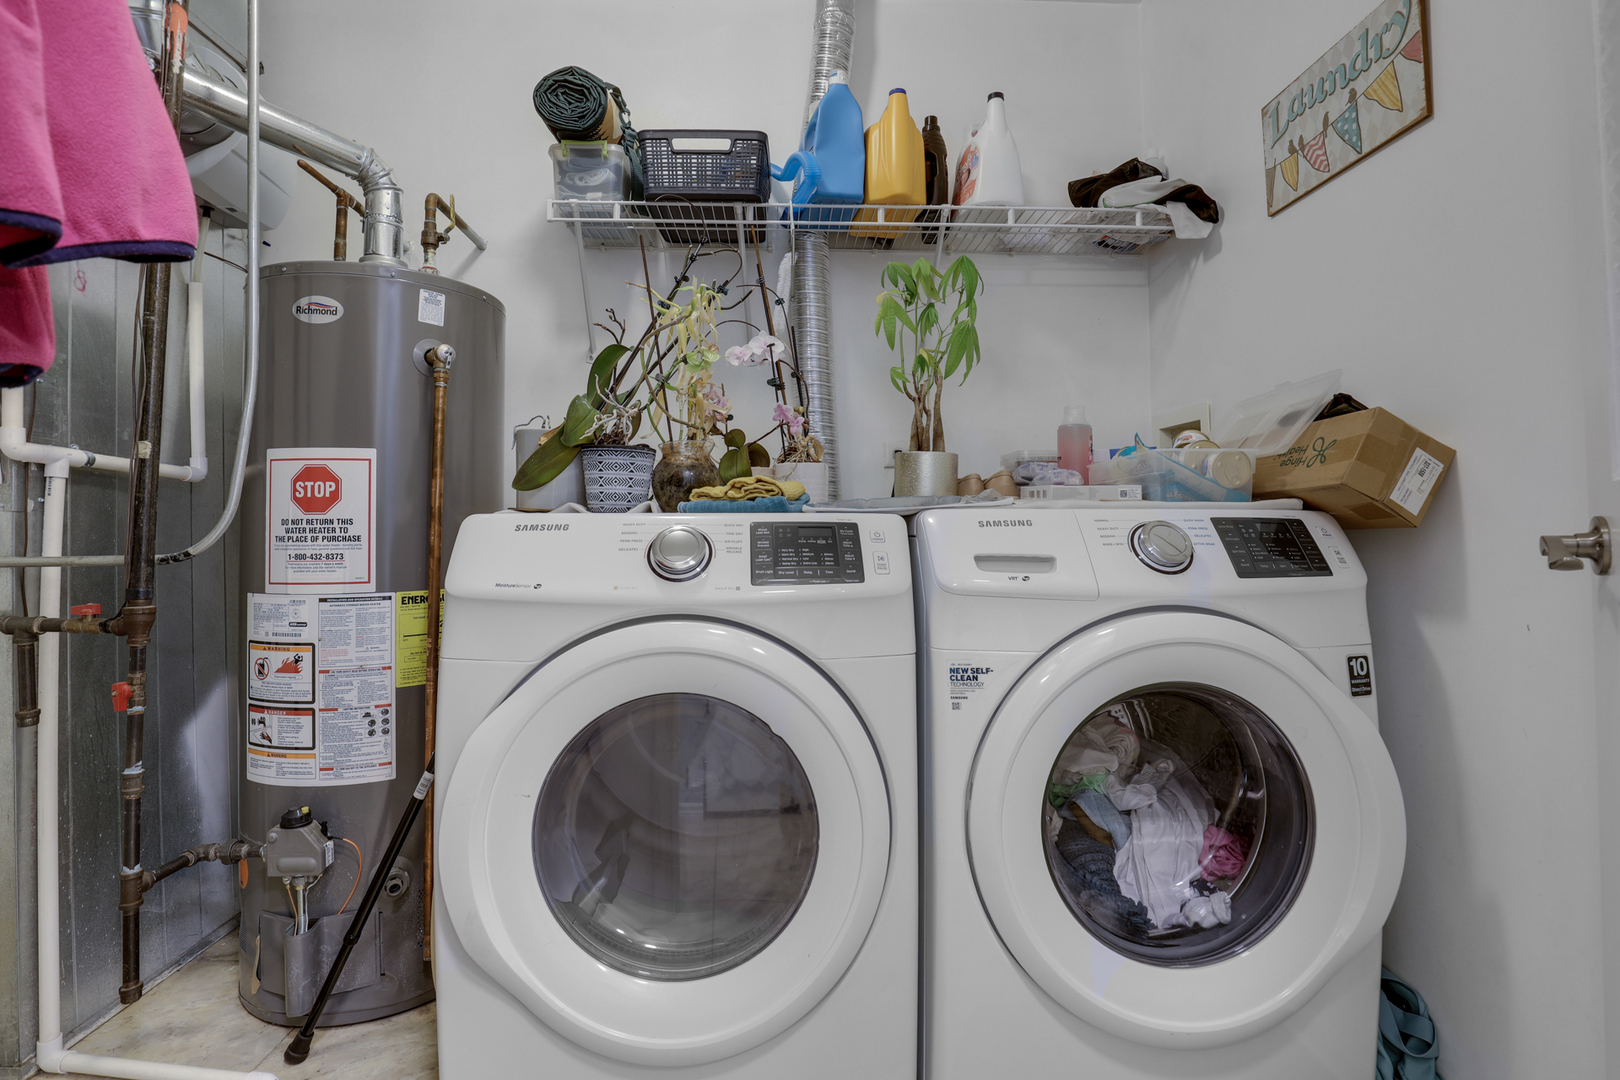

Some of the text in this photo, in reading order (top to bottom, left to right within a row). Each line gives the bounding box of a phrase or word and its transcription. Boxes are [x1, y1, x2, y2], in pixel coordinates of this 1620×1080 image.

[1269, 0, 1410, 150] Laundry
[296, 306, 337, 316] Richmond
[1280, 456, 1308, 467] Hinge
[295, 482, 336, 497] STOP
[1350, 657, 1367, 676] 10
